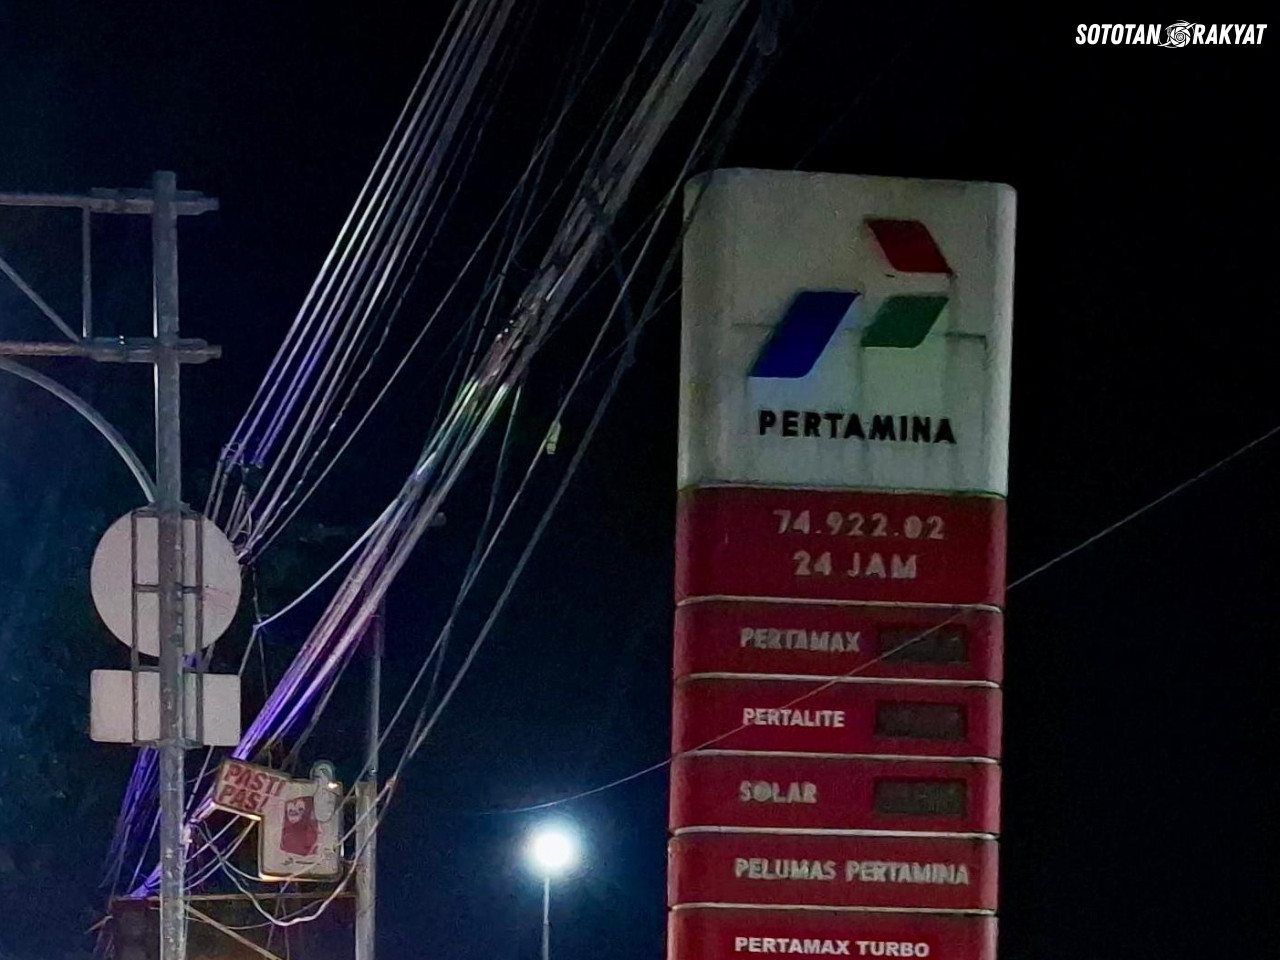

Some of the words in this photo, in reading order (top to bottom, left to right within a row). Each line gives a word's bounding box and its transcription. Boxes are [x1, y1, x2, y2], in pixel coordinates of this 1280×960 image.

[758, 410, 956, 444] PERTAMINA
[773, 509, 945, 540] 74.922.02
[793, 550, 832, 576] 24
[847, 552, 917, 579] JAM
[740, 627, 860, 652] PERTAMAX
[743, 708, 845, 728] PERTALITE
[224, 764, 286, 796] PASTI
[739, 780, 818, 803] SOLAR
[734, 858, 837, 880] PELUMAS
[845, 861, 970, 885] PERTAMINA
[734, 936, 850, 955] PERTAMAX
[855, 940, 930, 957] TURBO
